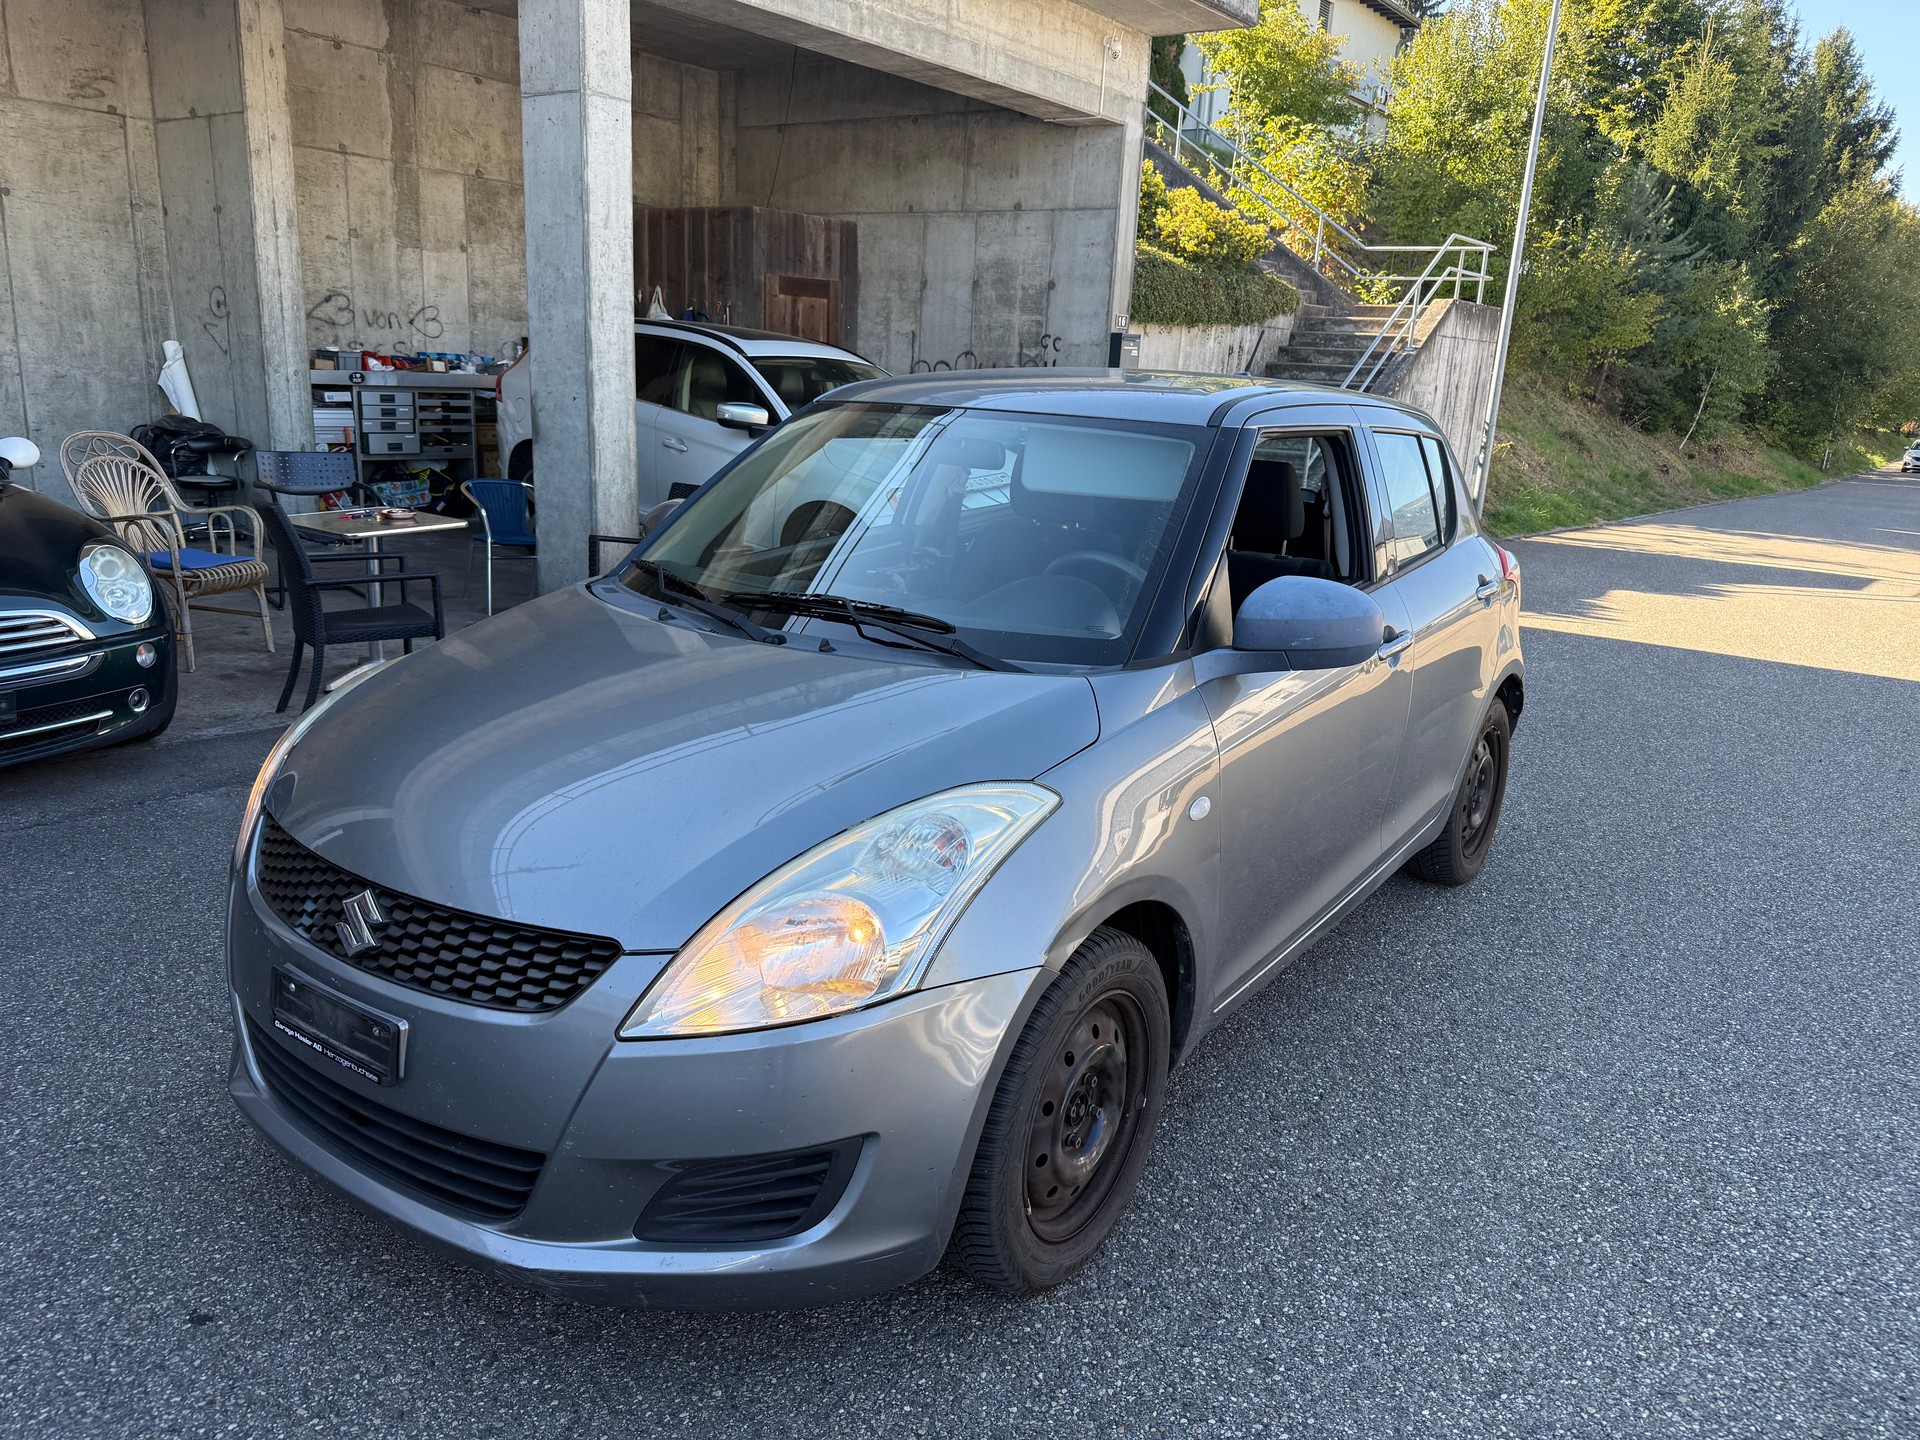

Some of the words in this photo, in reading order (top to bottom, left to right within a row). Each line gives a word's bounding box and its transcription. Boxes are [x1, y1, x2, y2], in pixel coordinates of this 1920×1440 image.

[363, 309, 403, 330] von
[1118, 316, 1126, 327] 16
[1079, 959, 1133, 1003] GOODYEAR
[274, 1020, 295, 1036] Garage
[312, 1042, 323, 1052] AG
[323, 1047, 379, 1083] Herzogenbuchsee
